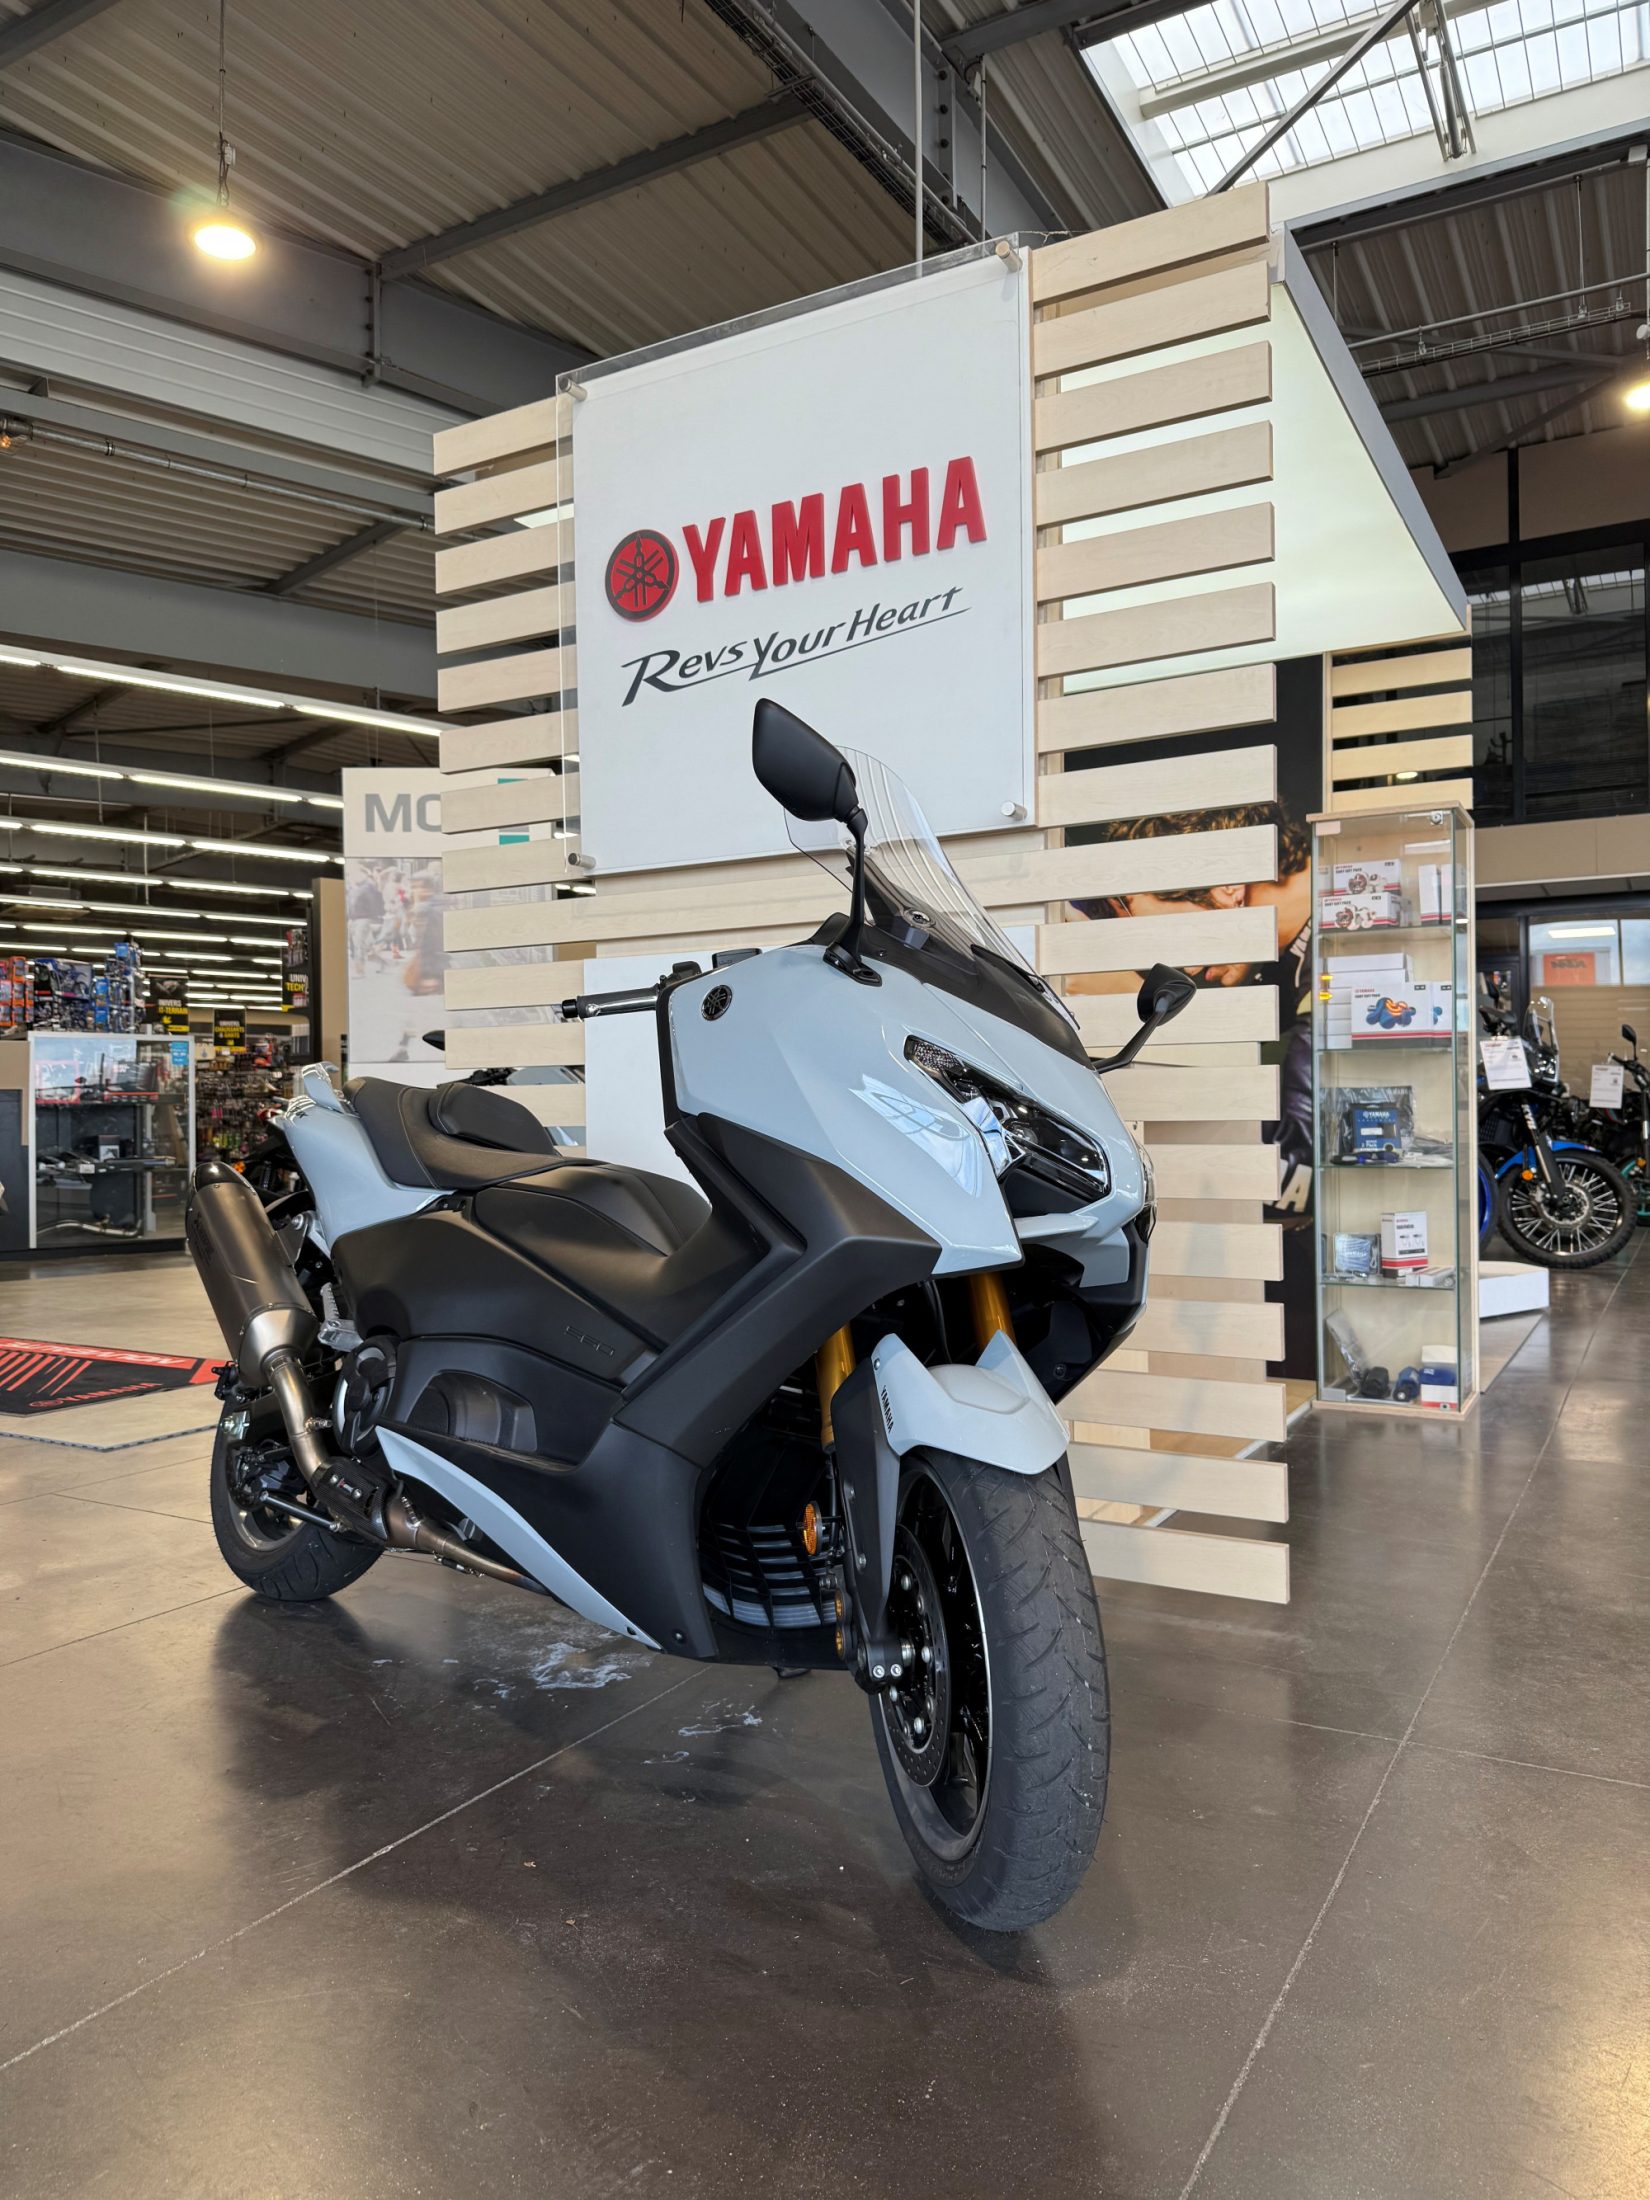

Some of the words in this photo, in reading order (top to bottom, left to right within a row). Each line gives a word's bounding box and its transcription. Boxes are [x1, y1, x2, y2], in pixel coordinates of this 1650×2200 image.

[682, 456, 987, 603] YAMAHA
[621, 639, 750, 707] Revs
[748, 620, 848, 681] Your
[846, 587, 963, 643] Heart
[880, 1384, 895, 1434] YAMAHA
